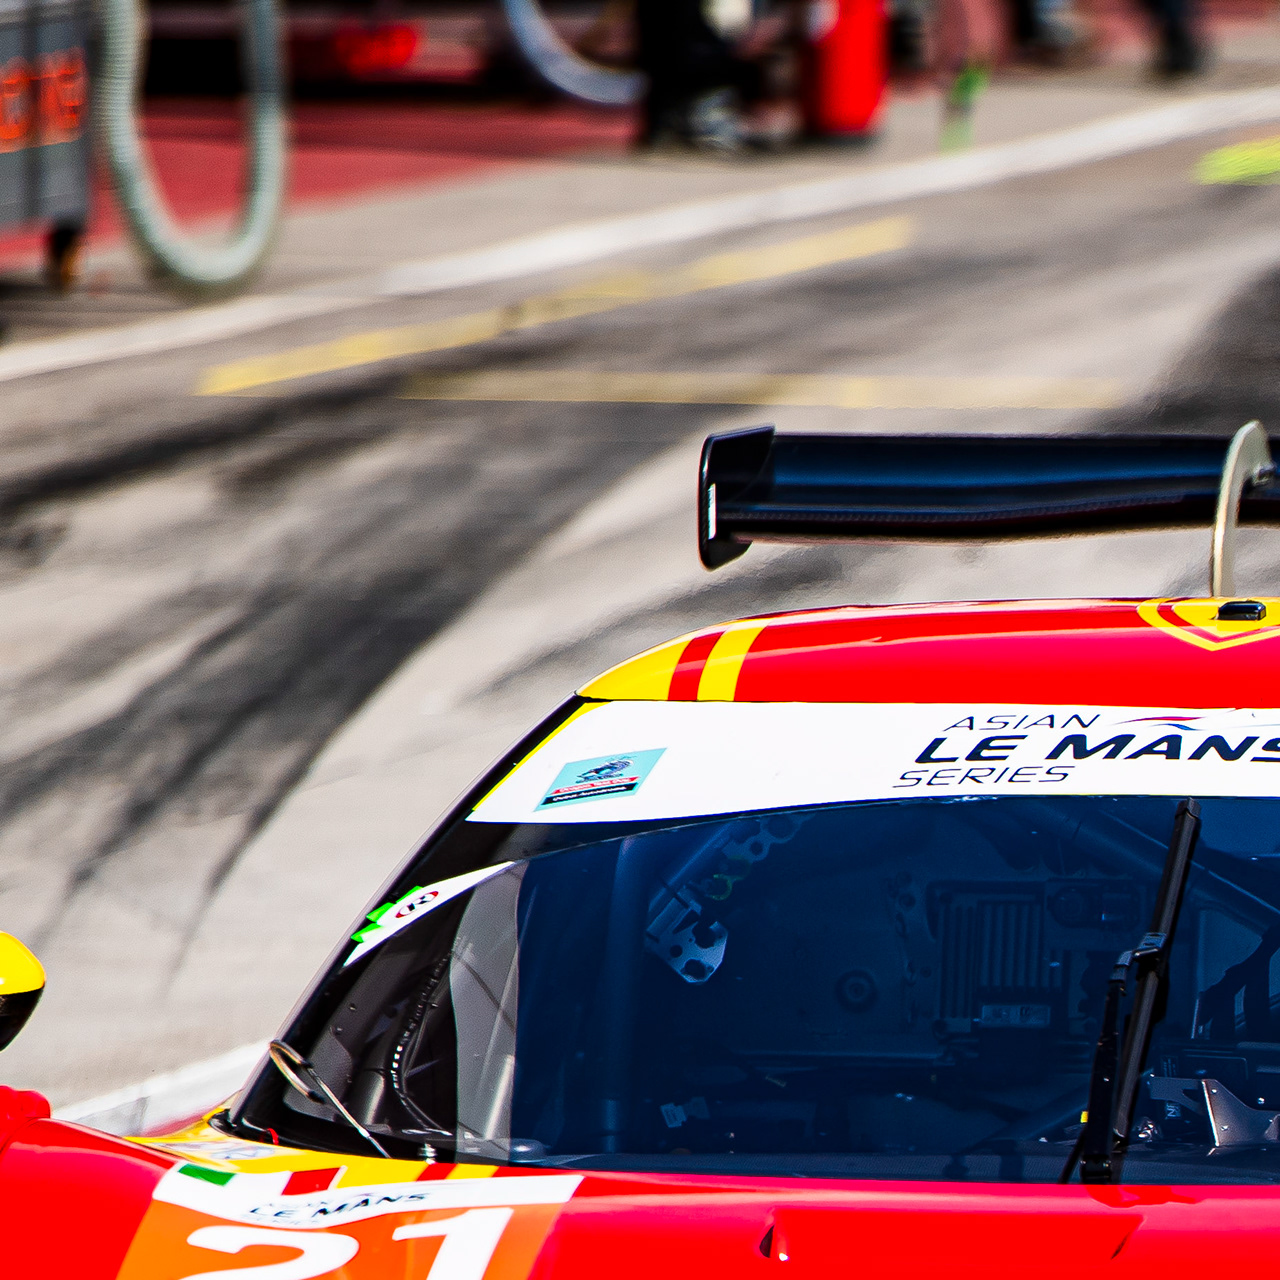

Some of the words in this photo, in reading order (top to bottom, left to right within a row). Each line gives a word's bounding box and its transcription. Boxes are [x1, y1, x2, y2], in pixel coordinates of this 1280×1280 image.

[943, 714, 1101, 732] ASIAN
[915, 734, 1029, 764] LE
[893, 765, 1076, 789] SERIES
